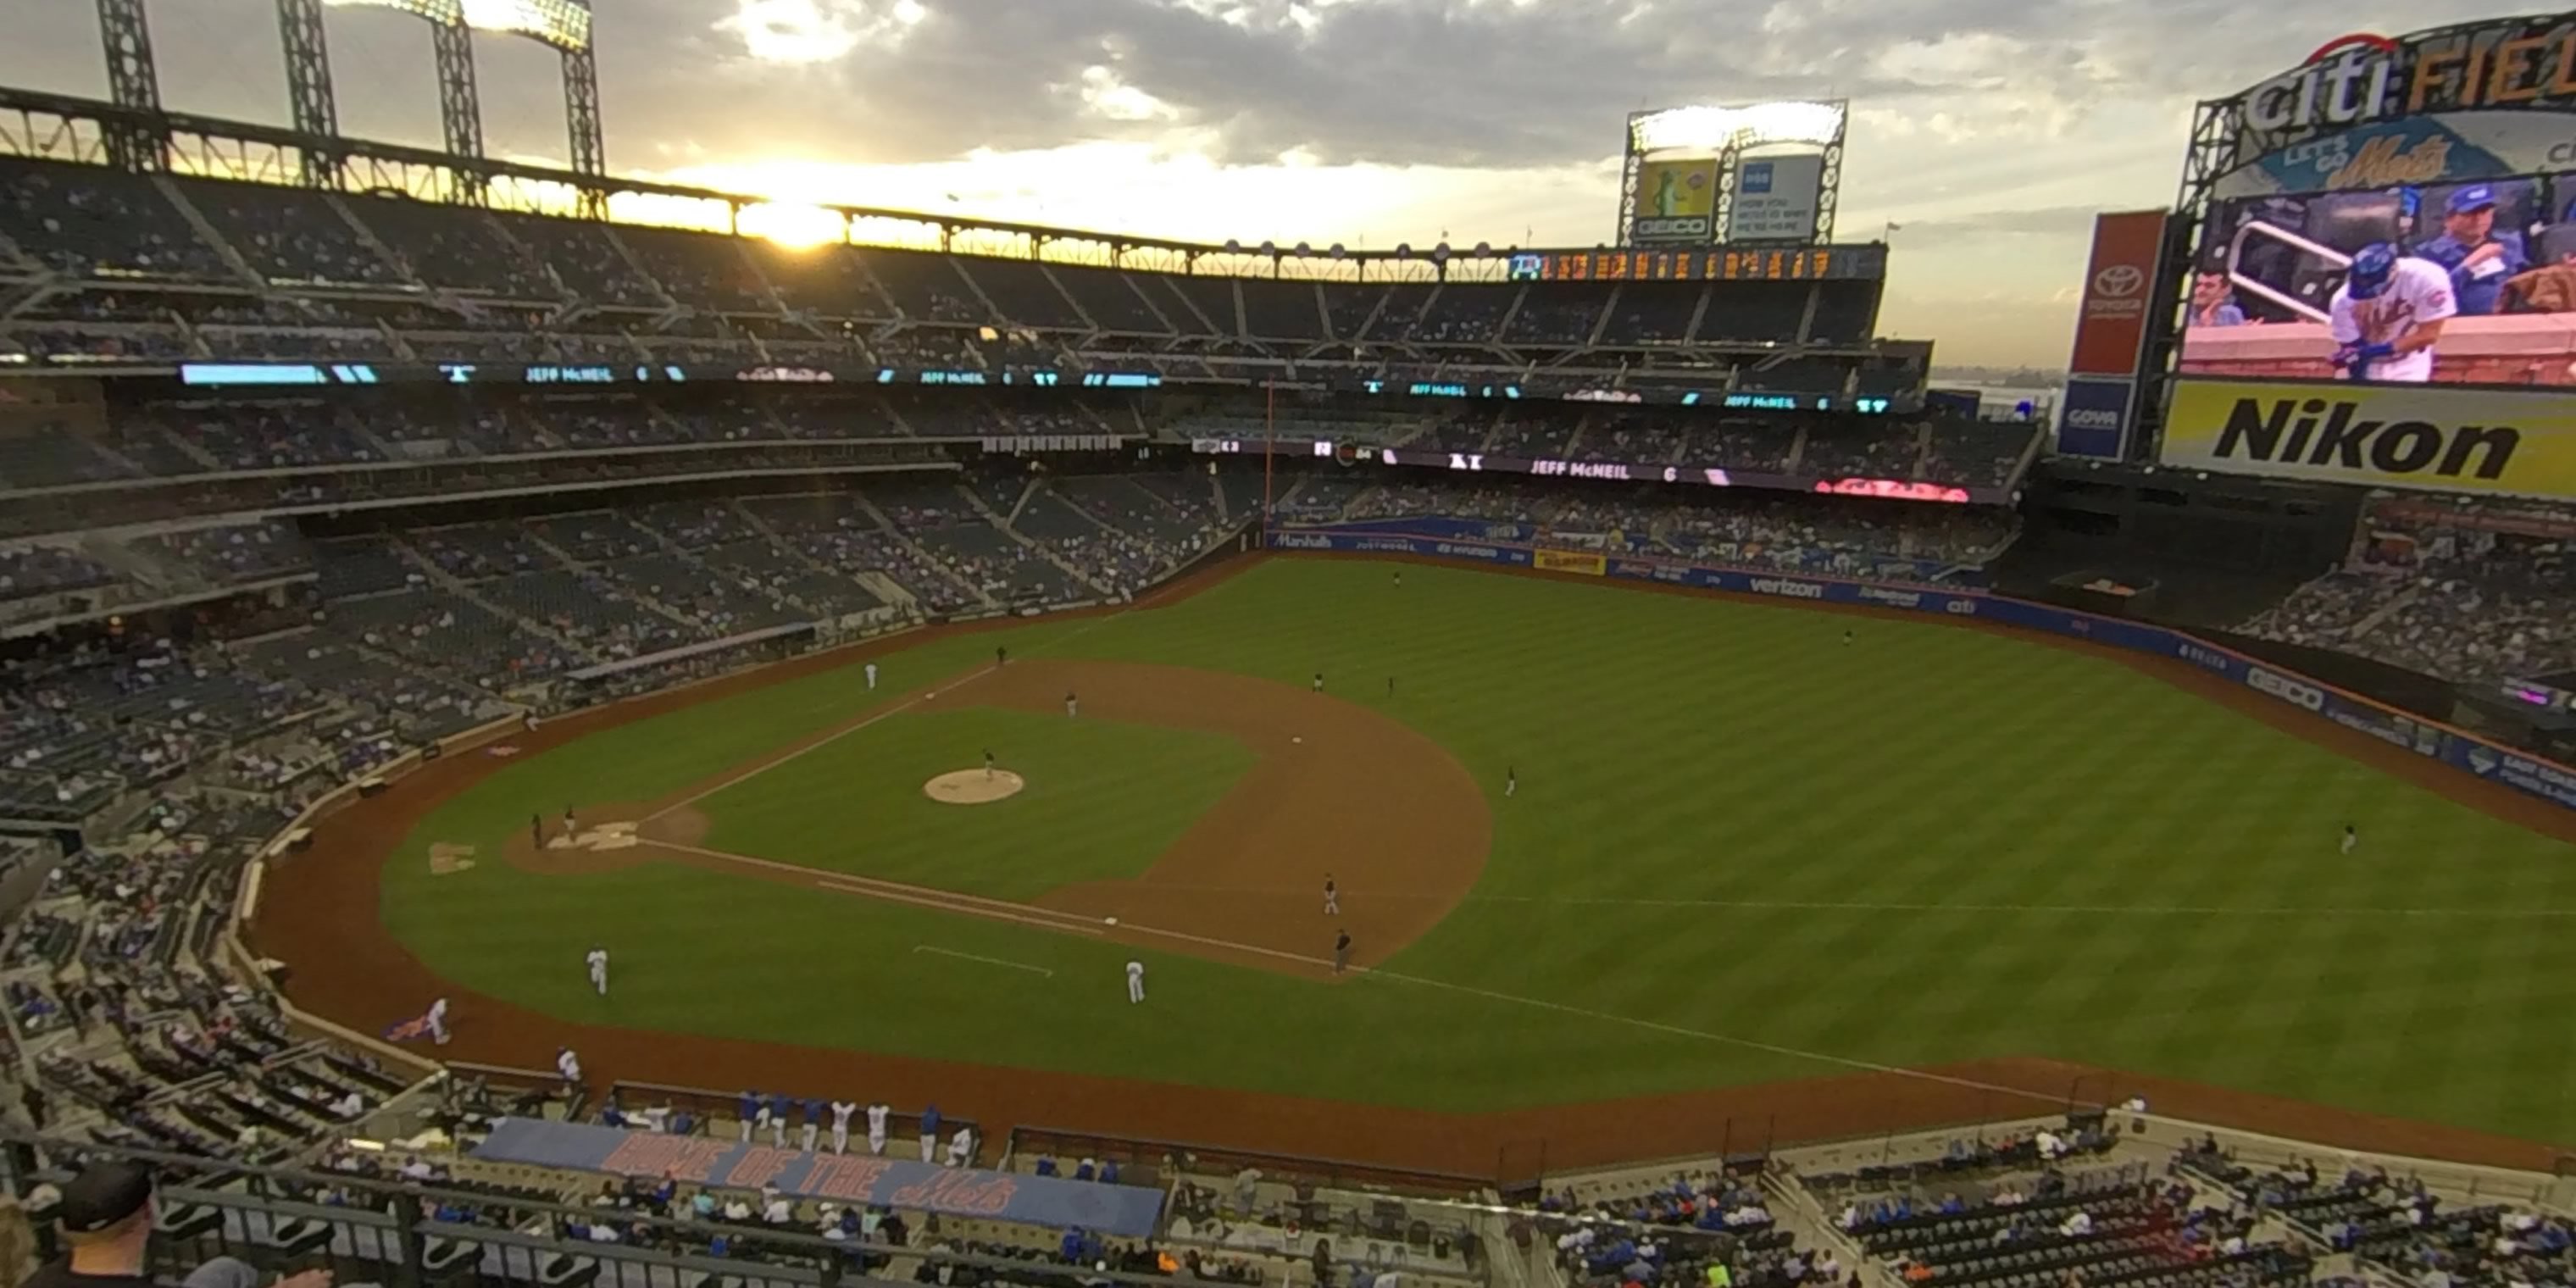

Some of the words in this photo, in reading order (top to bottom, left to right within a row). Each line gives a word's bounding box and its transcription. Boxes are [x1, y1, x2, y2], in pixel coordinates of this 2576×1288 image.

[2246, 51, 2390, 130] citi
[2283, 135, 2348, 166] LET'S
[2325, 135, 2451, 189] Mets
[1638, 219, 1706, 235] GEICO
[2088, 299, 2142, 311] TOYOTA
[2068, 408, 2118, 425] GOYA
[2212, 397, 2520, 480] Nikon
[1530, 460, 1567, 475] JEFF
[1569, 463, 1631, 480] McNEIL
[1663, 467, 1677, 482] 6
[1750, 578, 1822, 598] verizon
[2246, 666, 2324, 712] GEICO
[600, 1130, 735, 1183] HOME
[725, 1145, 803, 1189] OF
[797, 1152, 894, 1203] THE
[889, 1166, 1018, 1216] Mets
